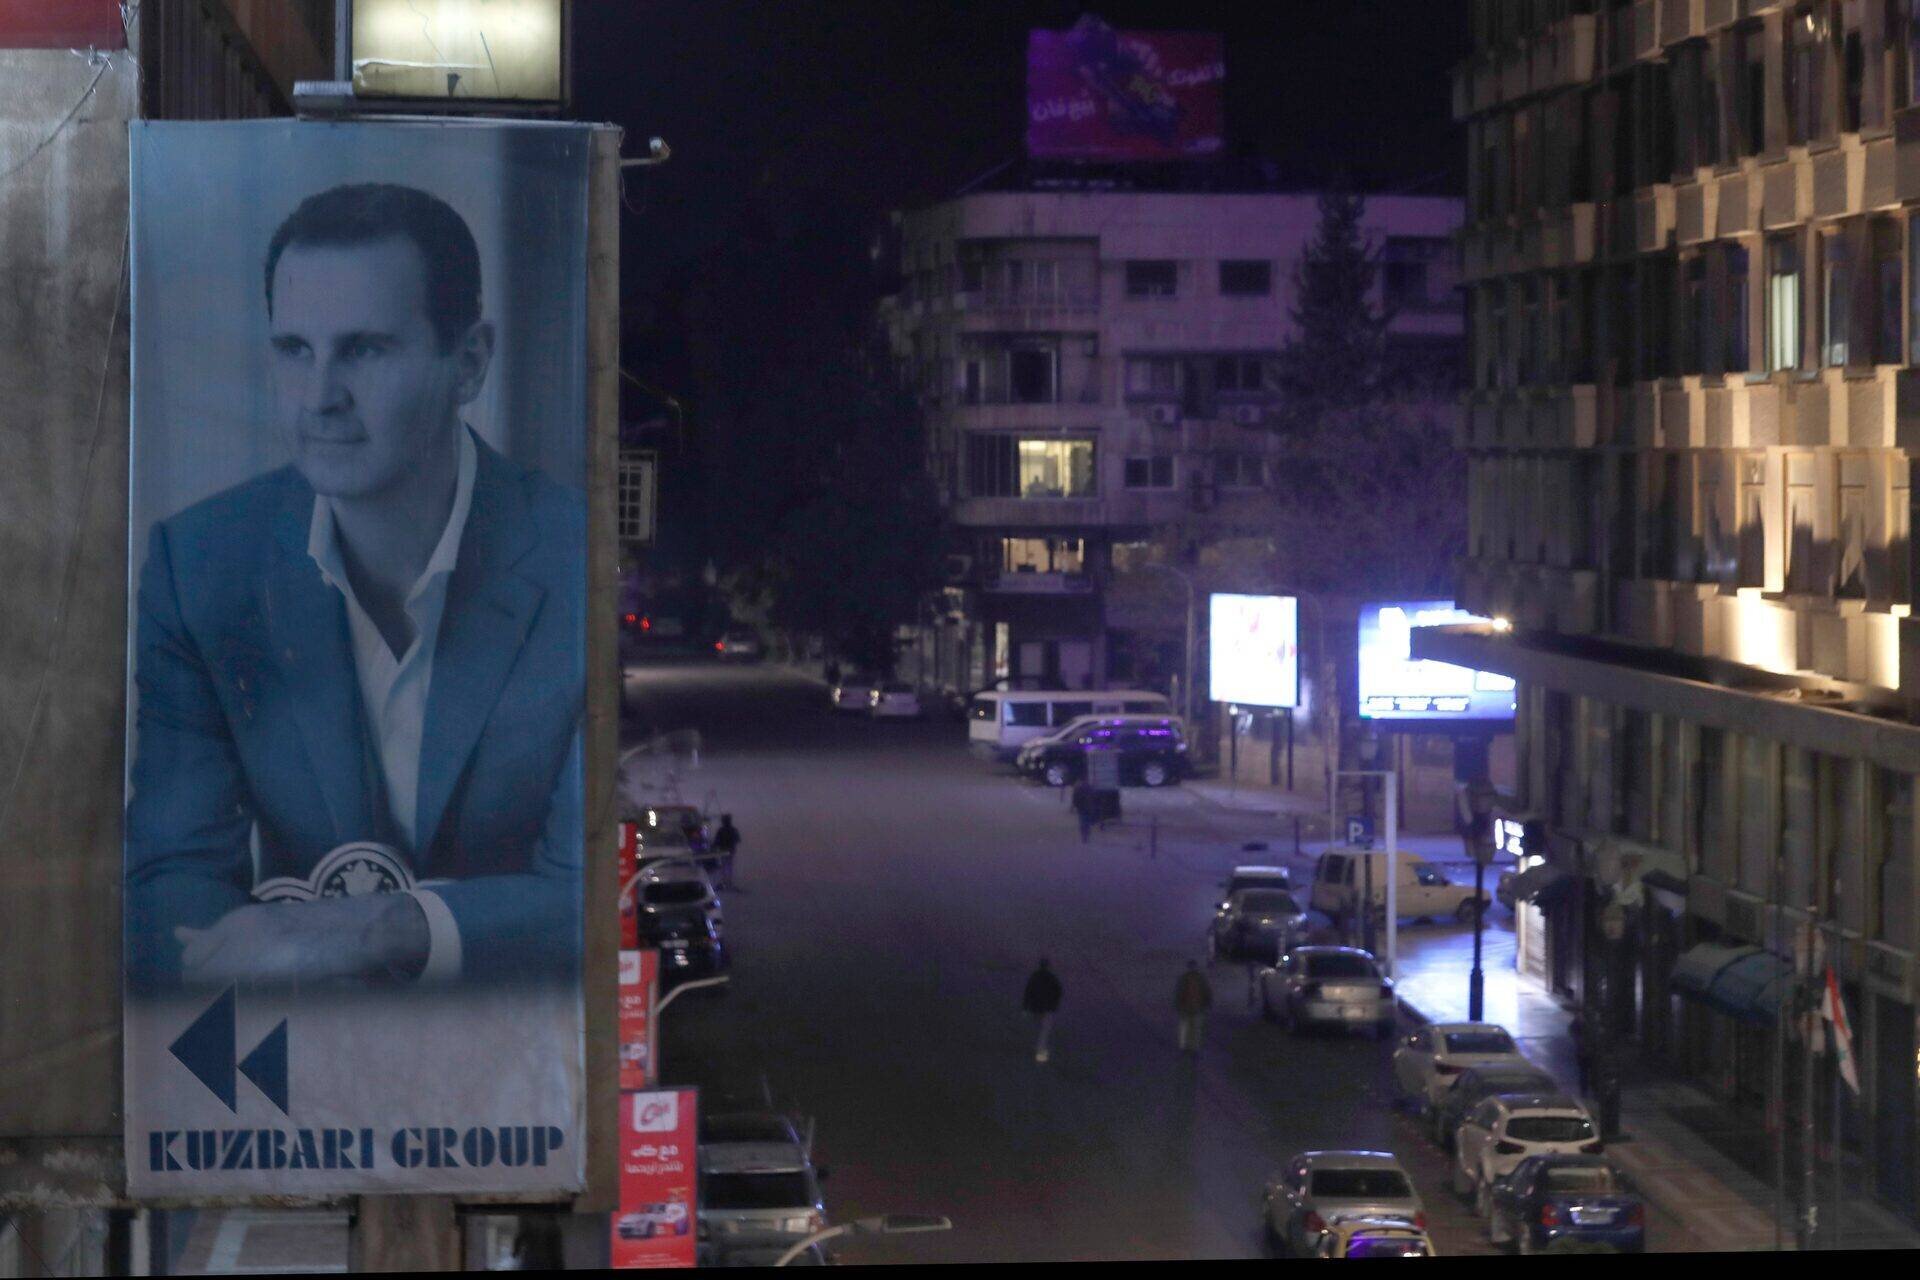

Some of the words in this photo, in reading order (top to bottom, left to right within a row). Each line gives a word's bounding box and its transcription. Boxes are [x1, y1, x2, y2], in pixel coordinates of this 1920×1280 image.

[1349, 821, 1364, 844] P
[149, 1128, 374, 1172] KUZBARI
[392, 1125, 564, 1169] GROUP
